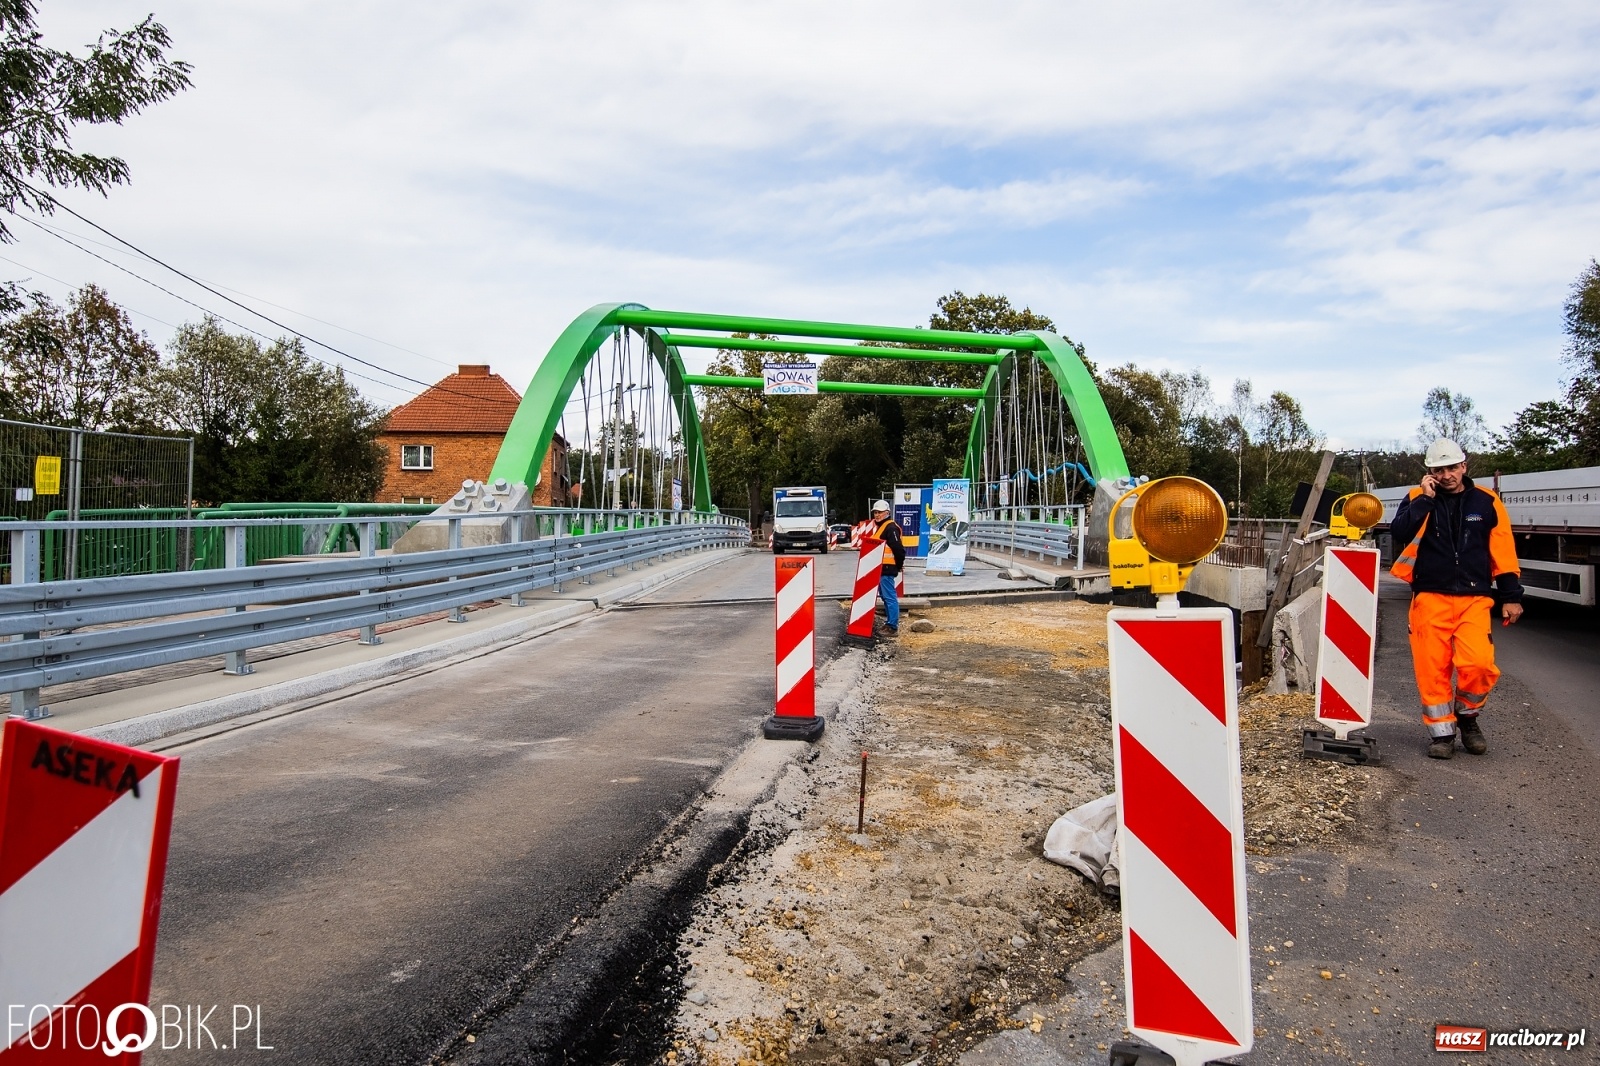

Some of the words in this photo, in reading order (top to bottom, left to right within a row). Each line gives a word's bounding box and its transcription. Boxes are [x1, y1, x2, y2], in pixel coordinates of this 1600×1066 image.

[767, 371, 813, 386] NOWAK
[772, 385, 809, 393] MOSTY
[937, 483, 964, 493] NOWAK
[31, 740, 141, 799] ASEKA
